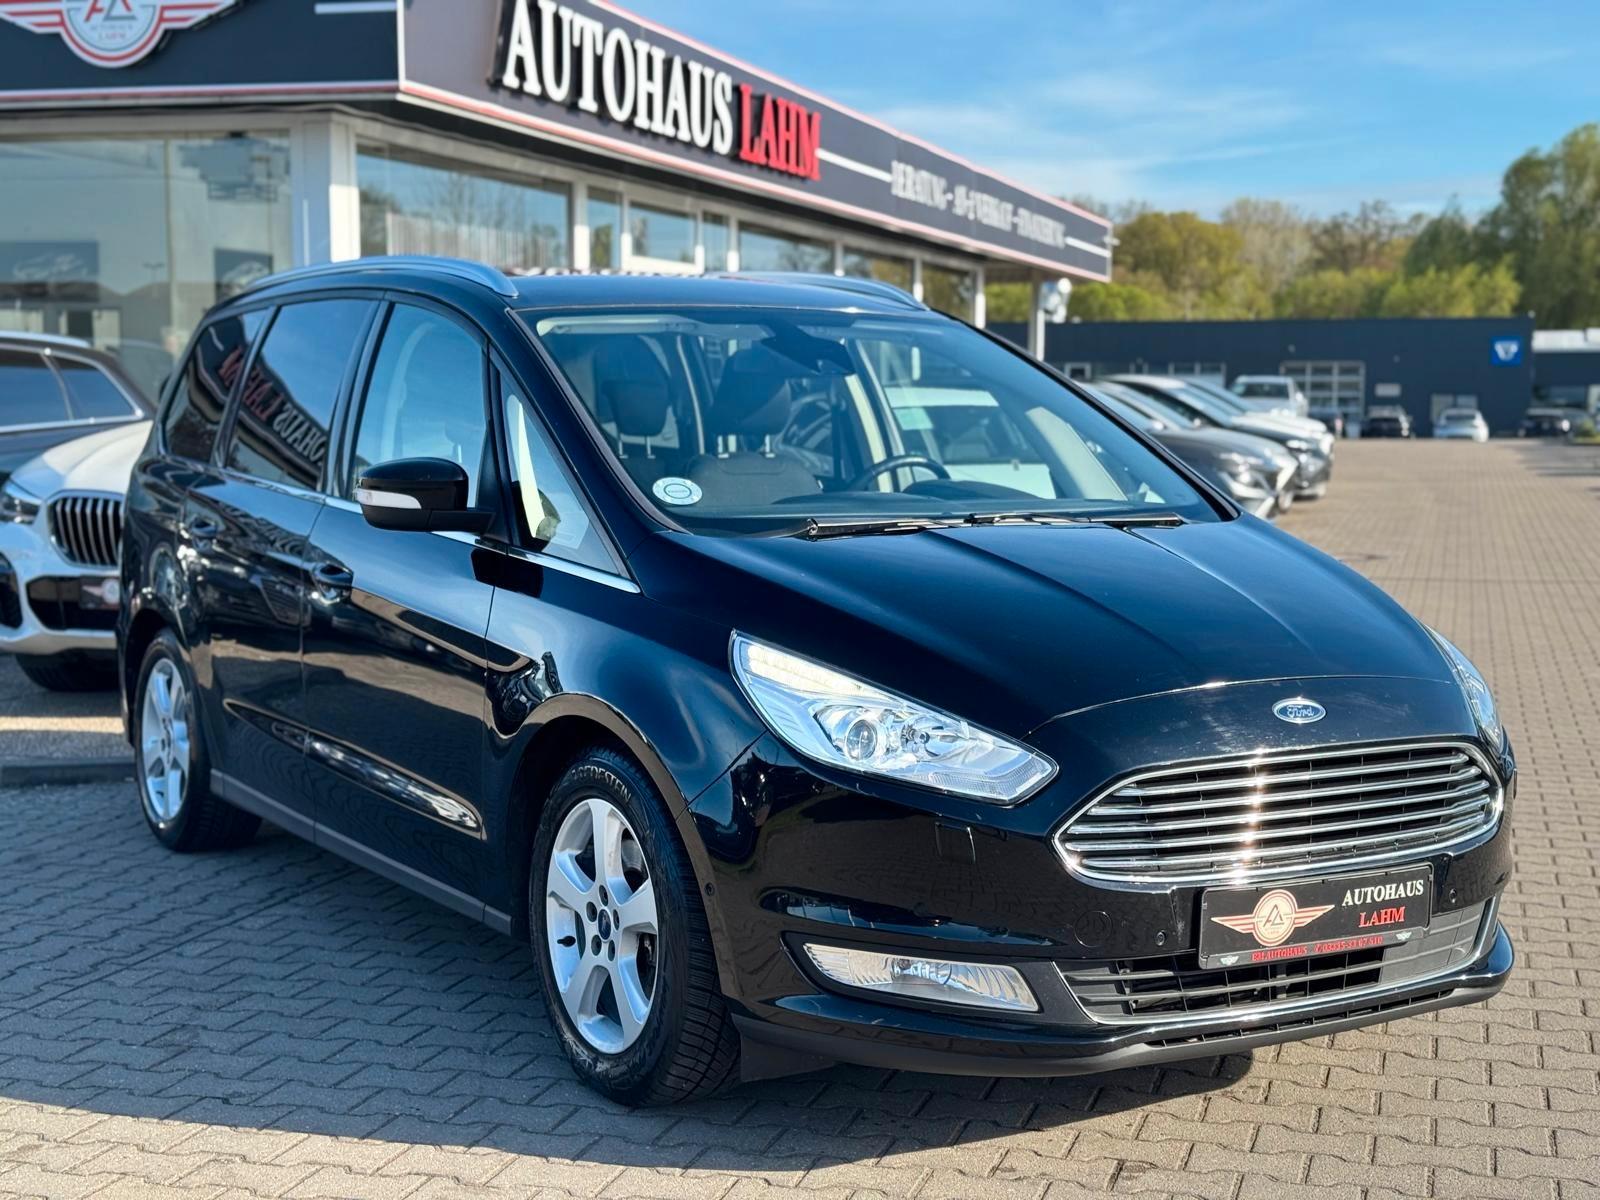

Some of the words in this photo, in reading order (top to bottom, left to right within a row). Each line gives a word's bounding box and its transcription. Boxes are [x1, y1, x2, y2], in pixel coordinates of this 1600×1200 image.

[502, 0, 733, 155] AUTOHAUS
[739, 83, 821, 181] LAHM
[1286, 704, 1315, 718] Ford
[1342, 879, 1424, 907] AUTOHAUS
[1359, 906, 1406, 928] LAHM
